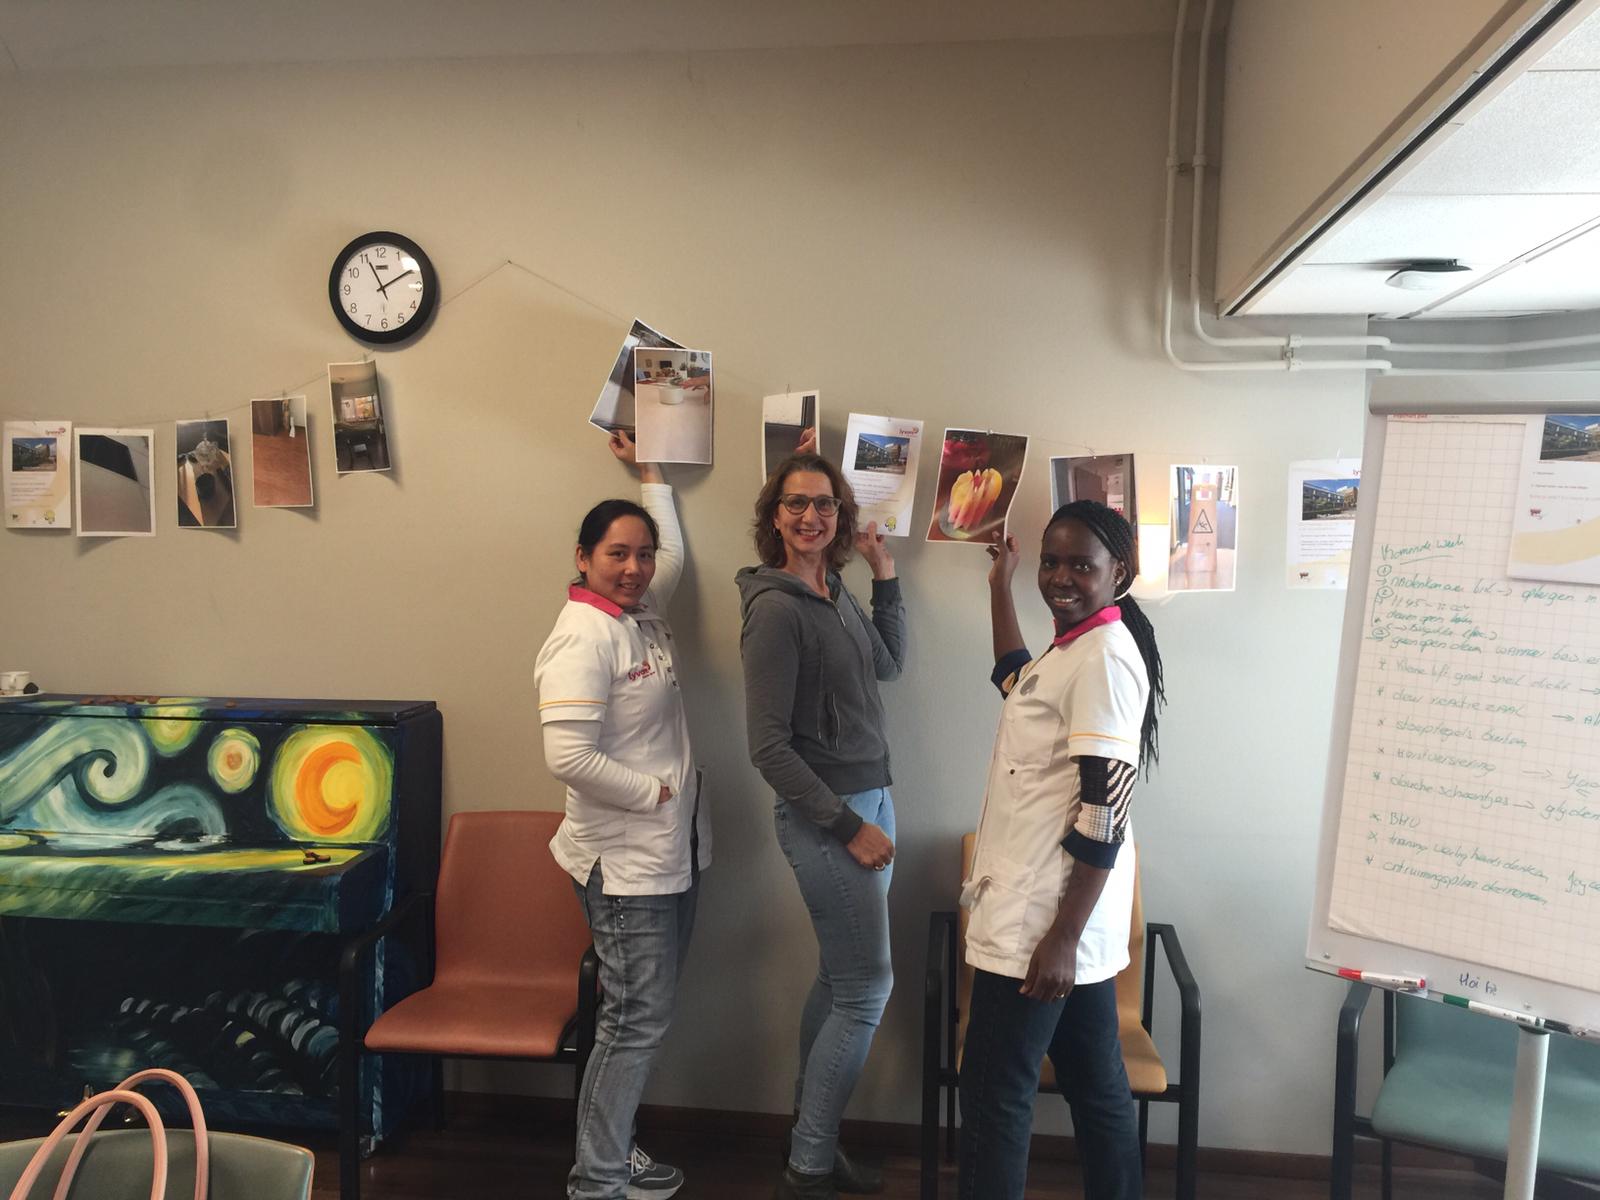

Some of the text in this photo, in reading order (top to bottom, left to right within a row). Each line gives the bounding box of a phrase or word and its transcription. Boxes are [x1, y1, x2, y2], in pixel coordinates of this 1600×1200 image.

[375, 247, 386, 258] 12
[396, 251, 401, 262] 1
[360, 253, 369, 264] 11
[348, 267, 360, 279] 10
[343, 284, 351, 296] 9
[350, 302, 358, 314] 8
[409, 300, 416, 310] 4
[365, 314, 372, 325] 7
[380, 318, 389, 329] 6
[397, 312, 405, 324] 5
